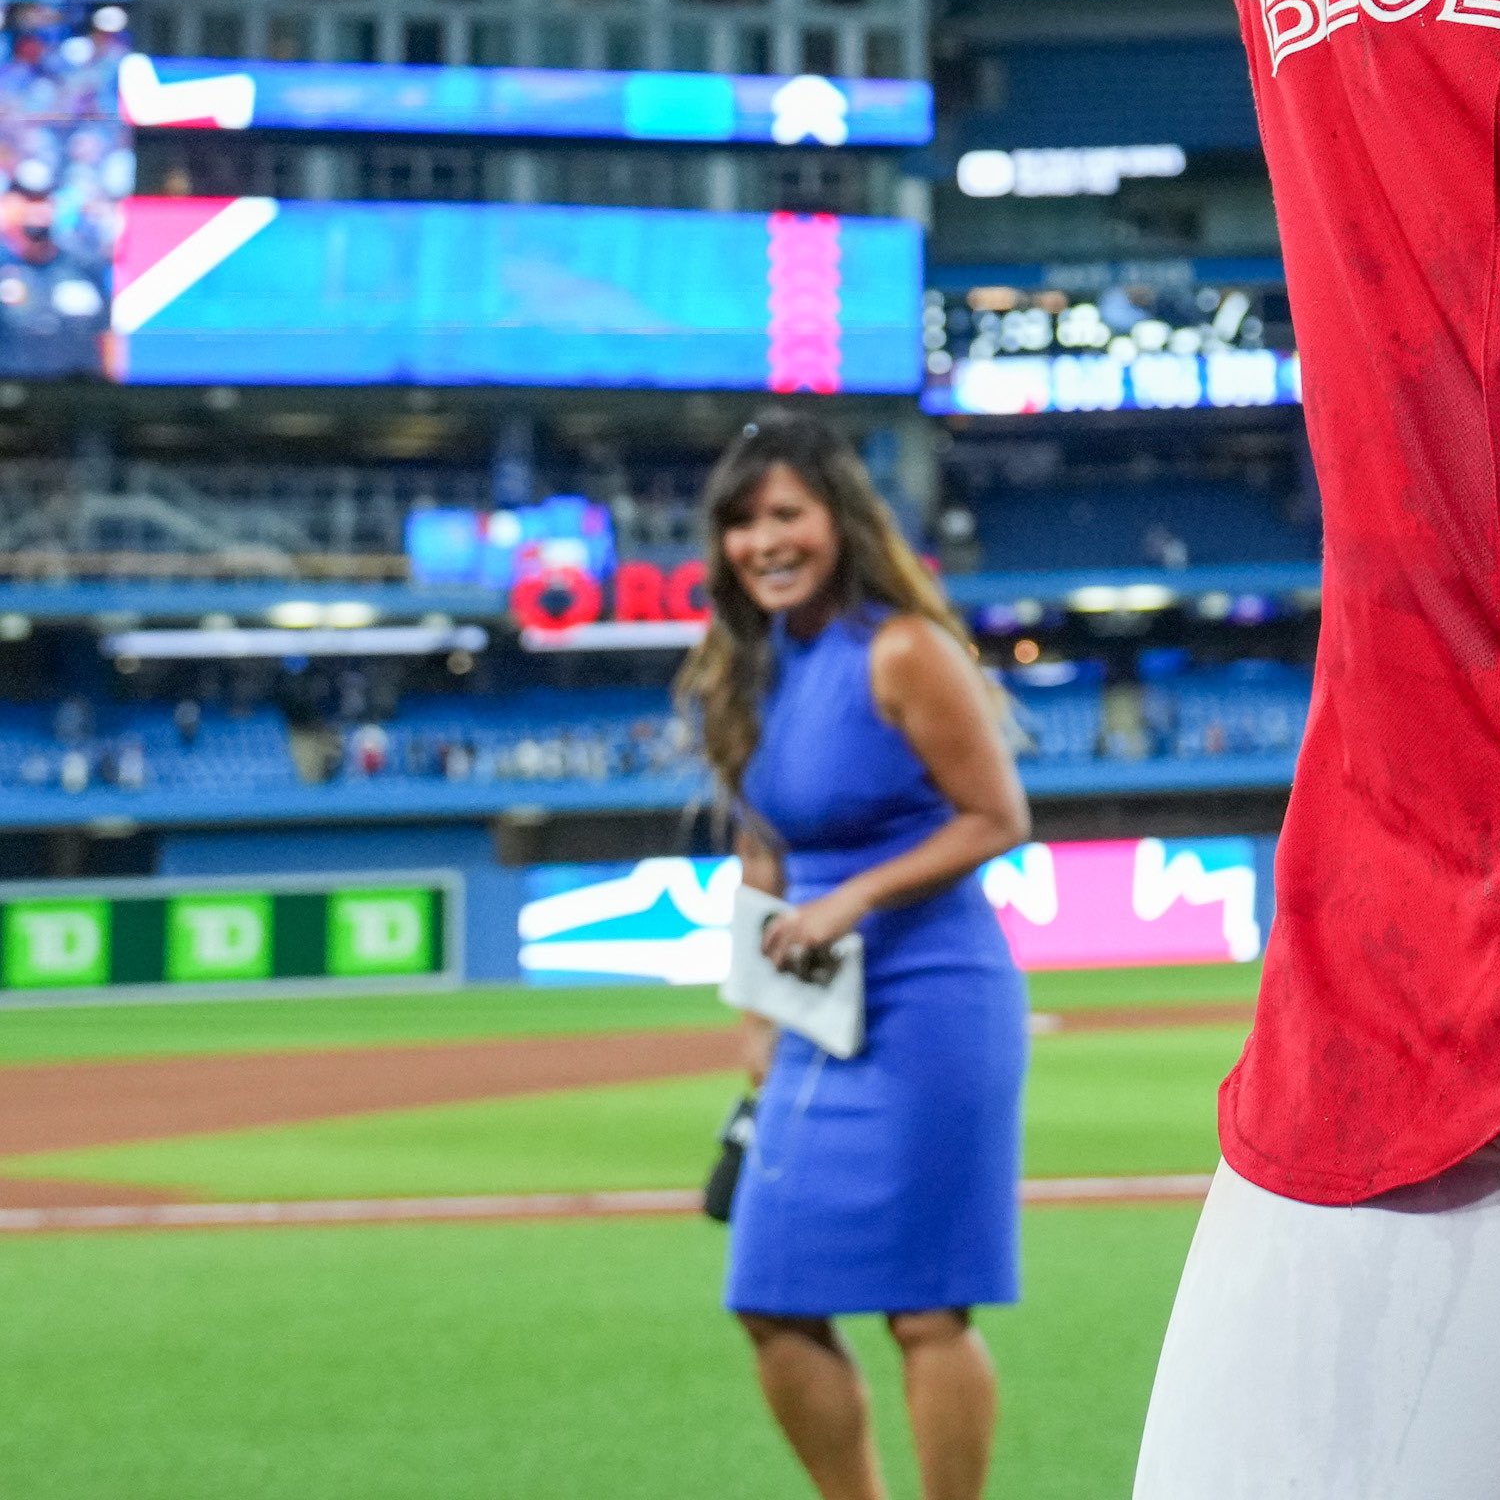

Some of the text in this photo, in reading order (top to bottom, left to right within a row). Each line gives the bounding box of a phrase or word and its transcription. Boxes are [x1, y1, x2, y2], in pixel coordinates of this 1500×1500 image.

[14, 899, 423, 972] TD TD TD
